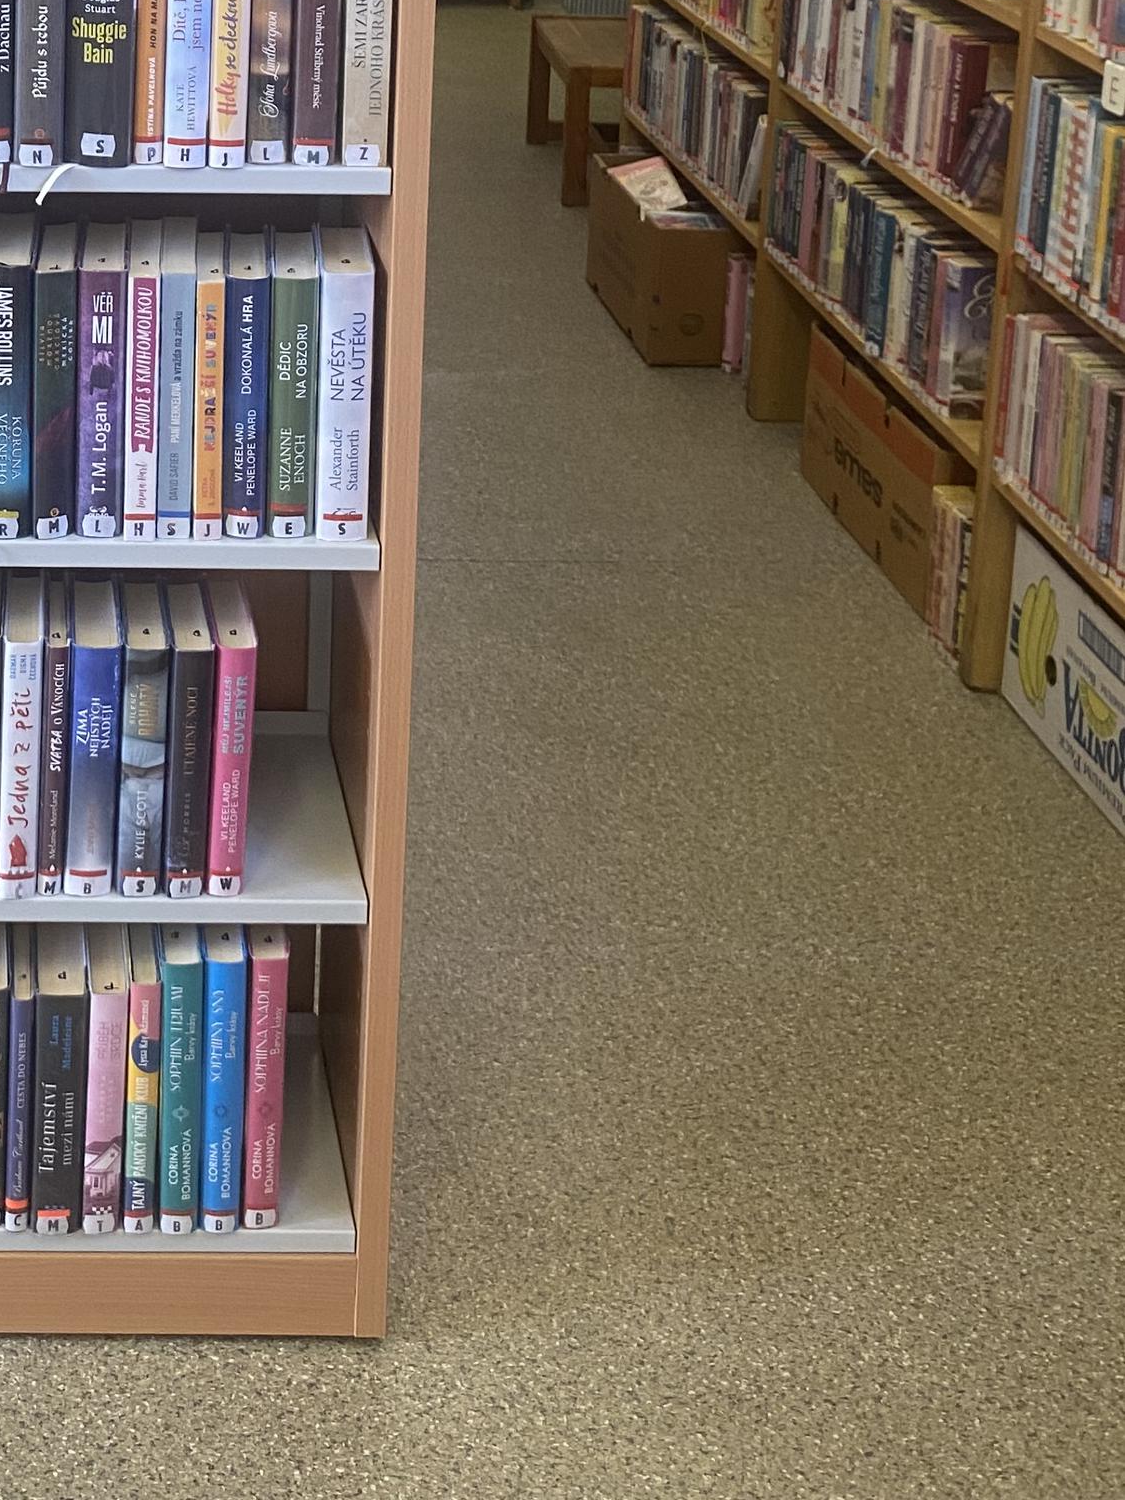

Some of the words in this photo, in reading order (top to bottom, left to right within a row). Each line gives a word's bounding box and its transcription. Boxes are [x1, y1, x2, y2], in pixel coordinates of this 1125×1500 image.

[34, 6, 49, 45] tebou
[85, 3, 116, 13] Stuart
[72, 17, 127, 39] Shuggie
[84, 43, 114, 63] Bain
[32, 60, 50, 98] Půjdu
[1109, 76, 1119, 105] E
[243, 295, 253, 322] HRA
[136, 287, 153, 383] KNIHOMOLKOU
[297, 324, 308, 376] OBZORU
[349, 312, 366, 369] ÚTĚKU
[241, 326, 253, 394] DOKONALÁ
[277, 342, 290, 380] DĚDIC
[328, 329, 345, 401] NEVĚSTA
[296, 380, 306, 398] NA
[351, 375, 365, 401] NA
[137, 397, 153, 438] RANDE
[247, 410, 256, 441] WARD
[235, 423, 244, 469] KEELAND
[280, 428, 292, 491] SUZANNE
[294, 434, 305, 483] ENOCH
[235, 472, 243, 482] VI
[247, 443, 256, 495] PENELOPE
[10, 687, 33, 730] pěti
[13, 743, 29, 753] z
[7, 765, 30, 828] Jedna
[38, 1082, 56, 1173] Tajemství
[63, 1092, 74, 1127] námi
[63, 1132, 74, 1165] mezi
[168, 1145, 179, 1184] CORINA
[179, 1129, 192, 1200] BOMANNOVÁ
[208, 1142, 218, 1182] CORINA
[221, 1127, 232, 1198] BOMANNOVÁ
[252, 1140, 262, 1179] CORINA
[265, 1123, 276, 1194] BOMANNOVÁ
